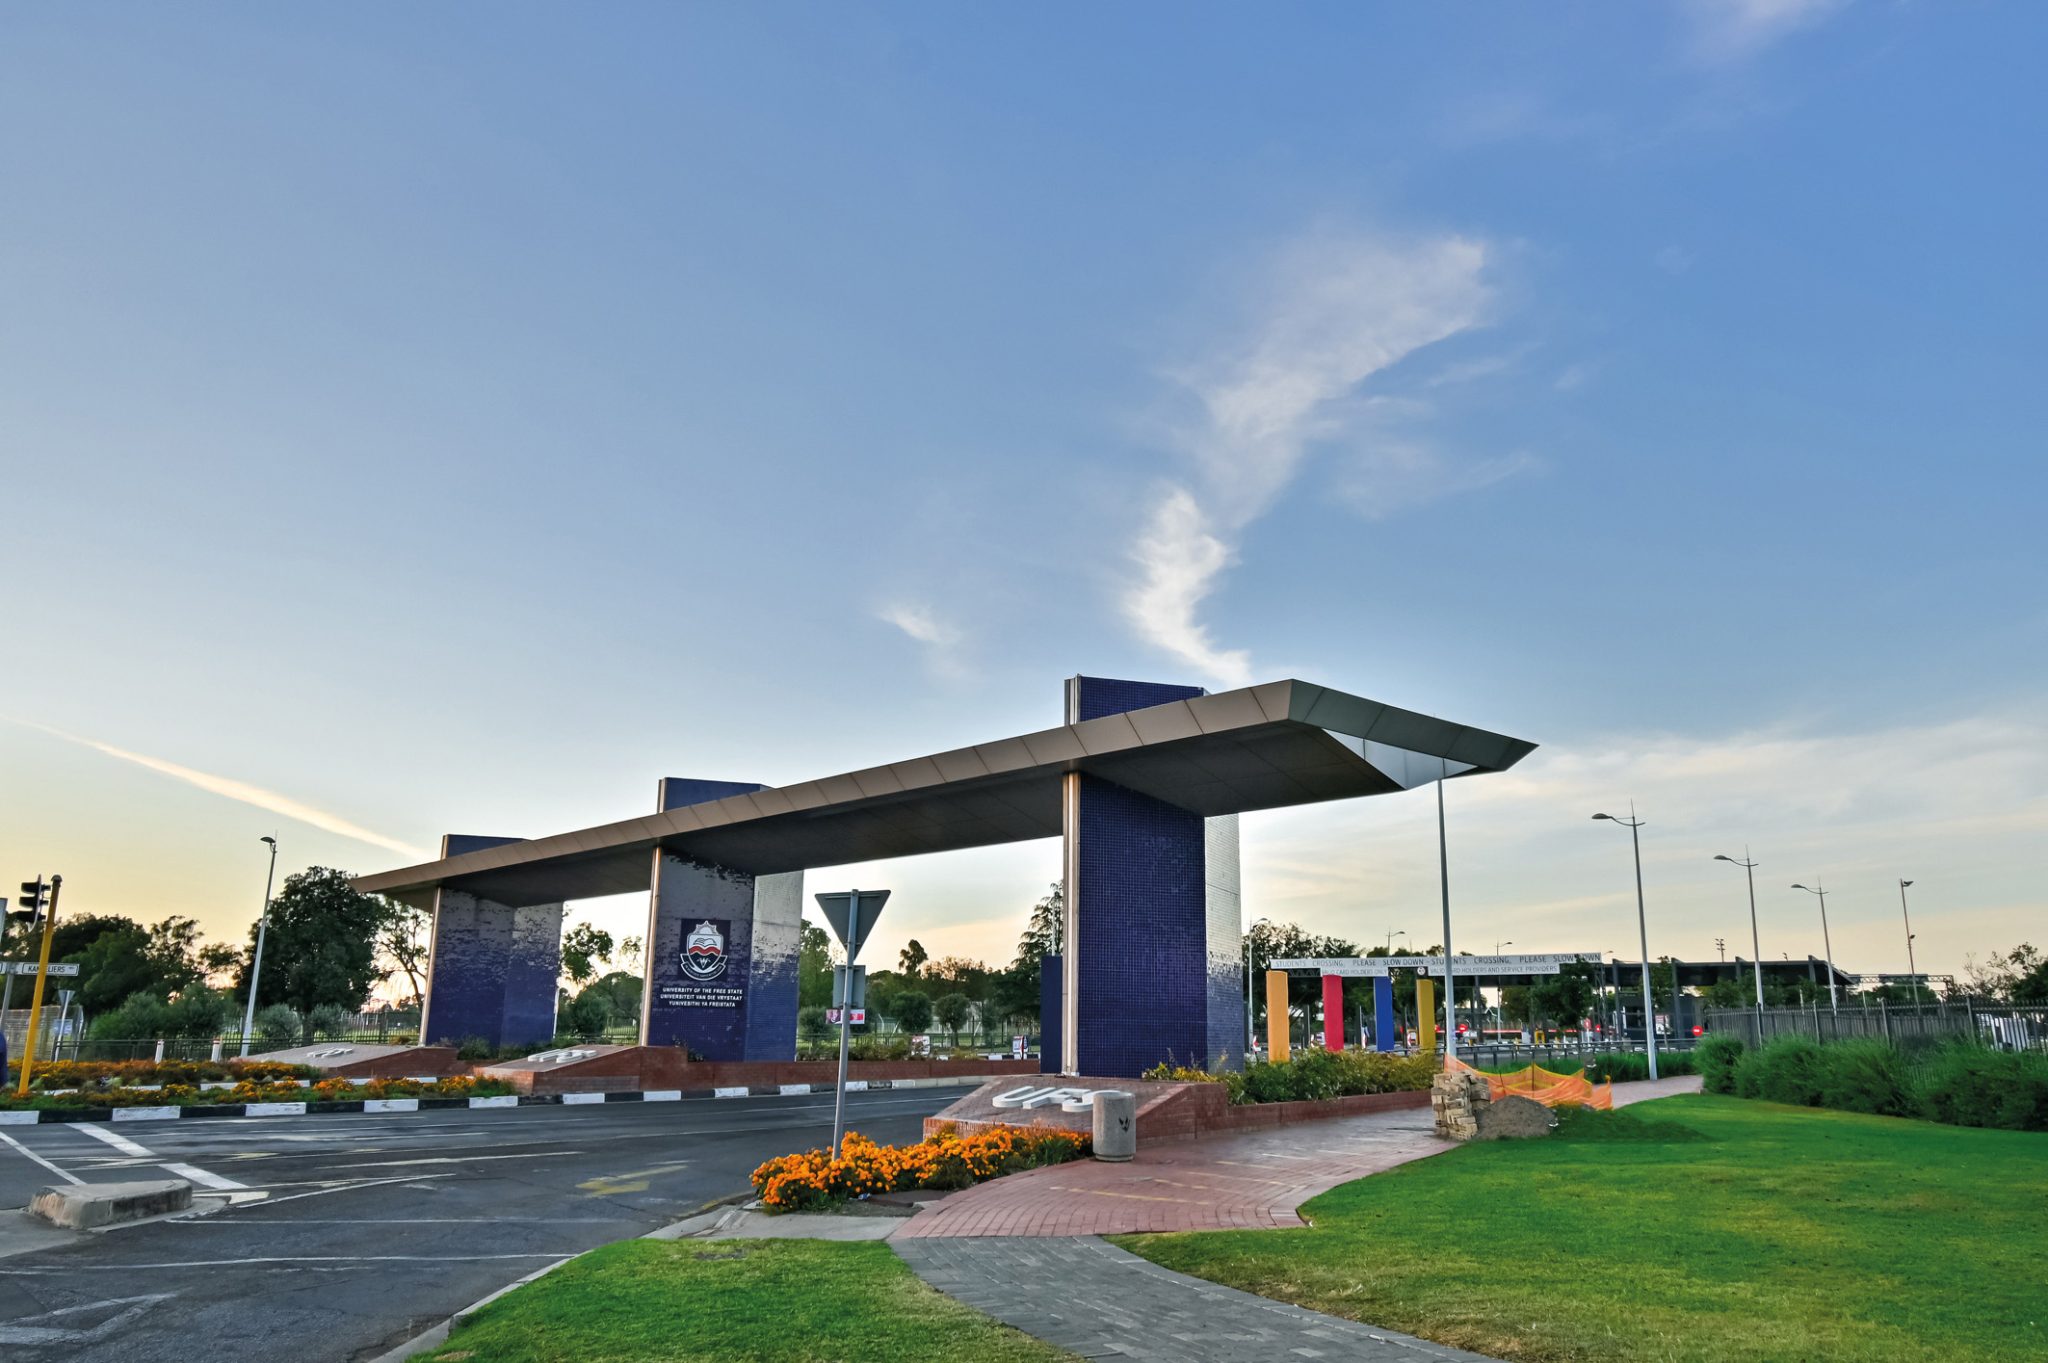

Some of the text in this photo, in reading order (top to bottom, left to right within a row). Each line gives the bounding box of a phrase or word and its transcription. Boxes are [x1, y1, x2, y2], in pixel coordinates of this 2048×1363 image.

[1352, 959, 1376, 967] PLEASE
[1402, 958, 1424, 966] DOWN
[1431, 957, 1467, 966] STUNTS
[1519, 955, 1547, 964] PLEASE
[1552, 954, 1574, 963] SLOW
[28, 965, 66, 973] KALIERS
[1500, 965, 1523, 973] SERVICE
[1525, 964, 1558, 972] PROVIDERS
[992, 1085, 1124, 1113] UFS
